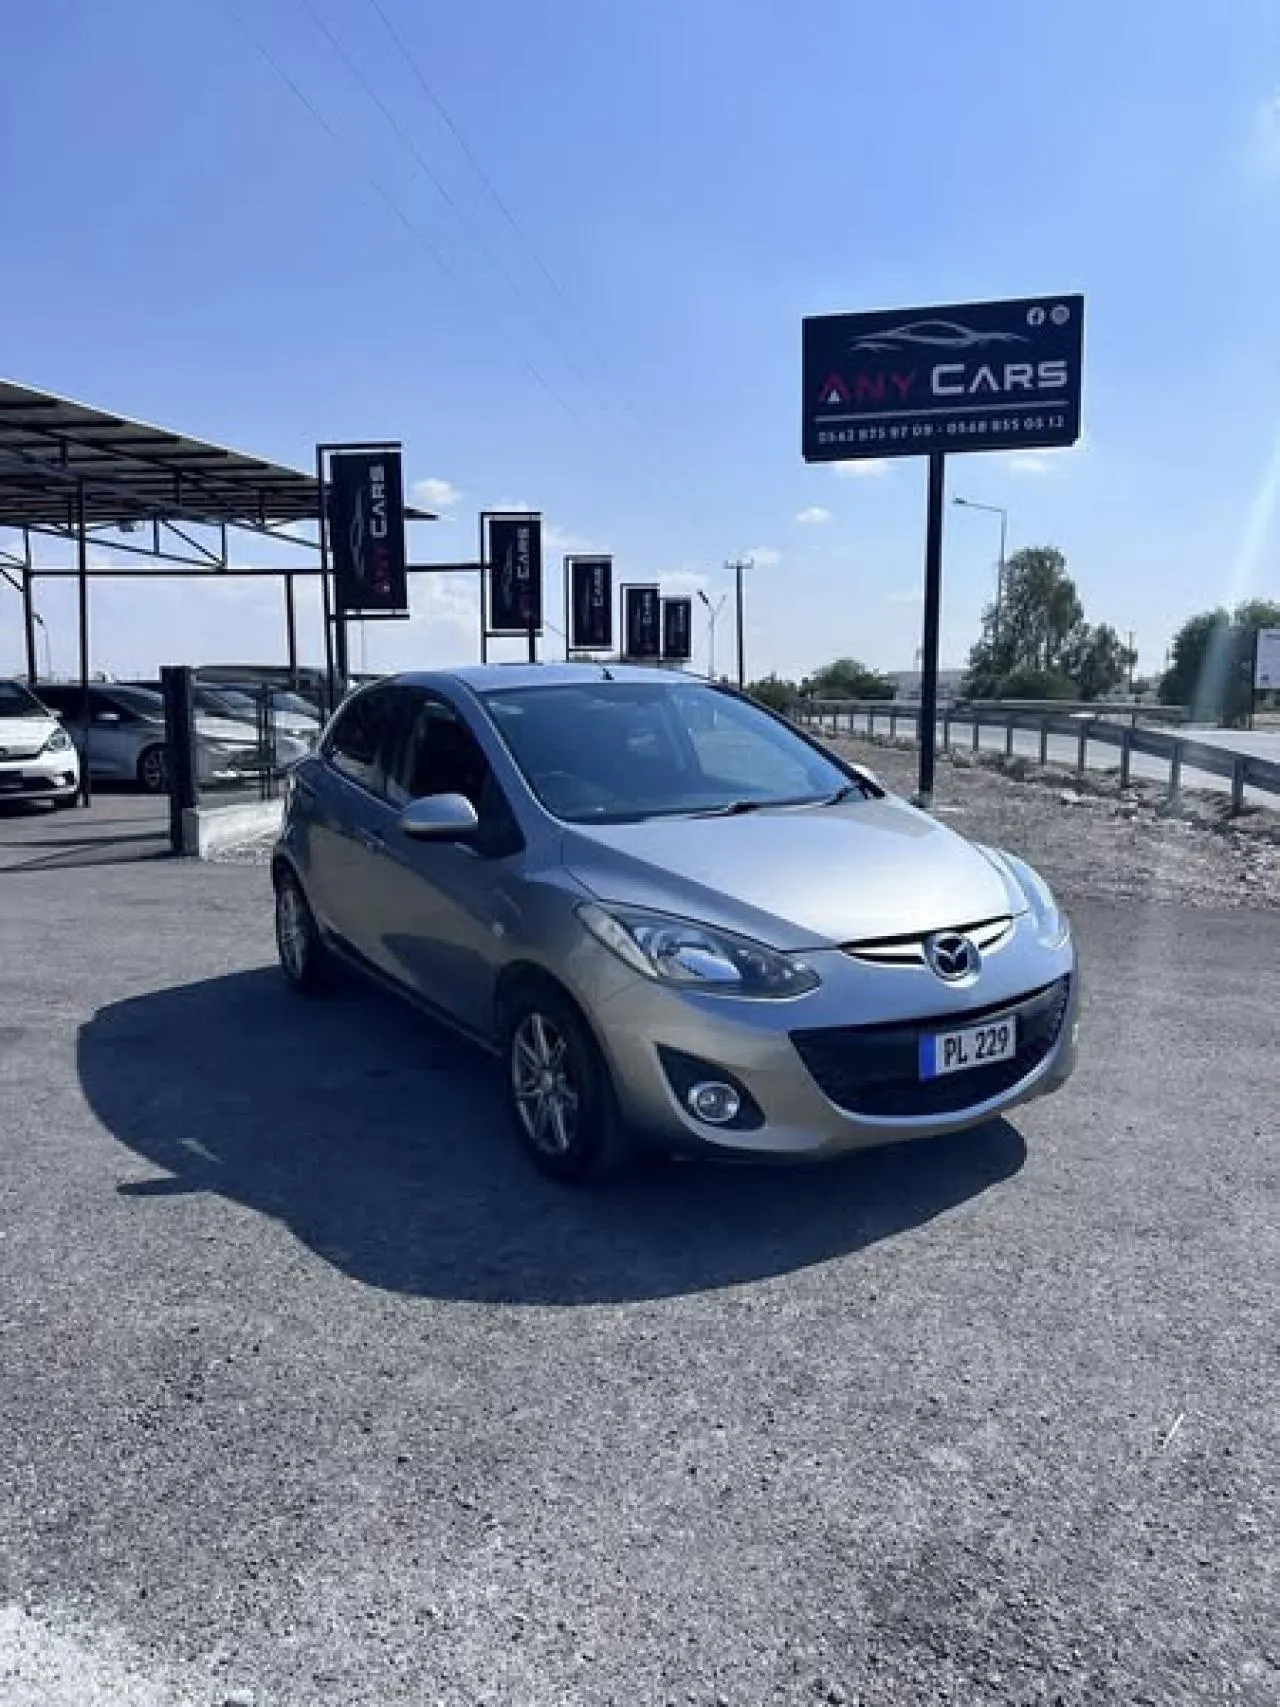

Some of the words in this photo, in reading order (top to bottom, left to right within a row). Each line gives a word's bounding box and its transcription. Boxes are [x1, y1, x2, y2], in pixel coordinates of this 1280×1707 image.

[818, 369, 916, 404] ANY
[931, 361, 1068, 396] CARS
[369, 465, 387, 538] CARS
[943, 1035, 968, 1068] PL
[975, 1025, 1008, 1059] 229
